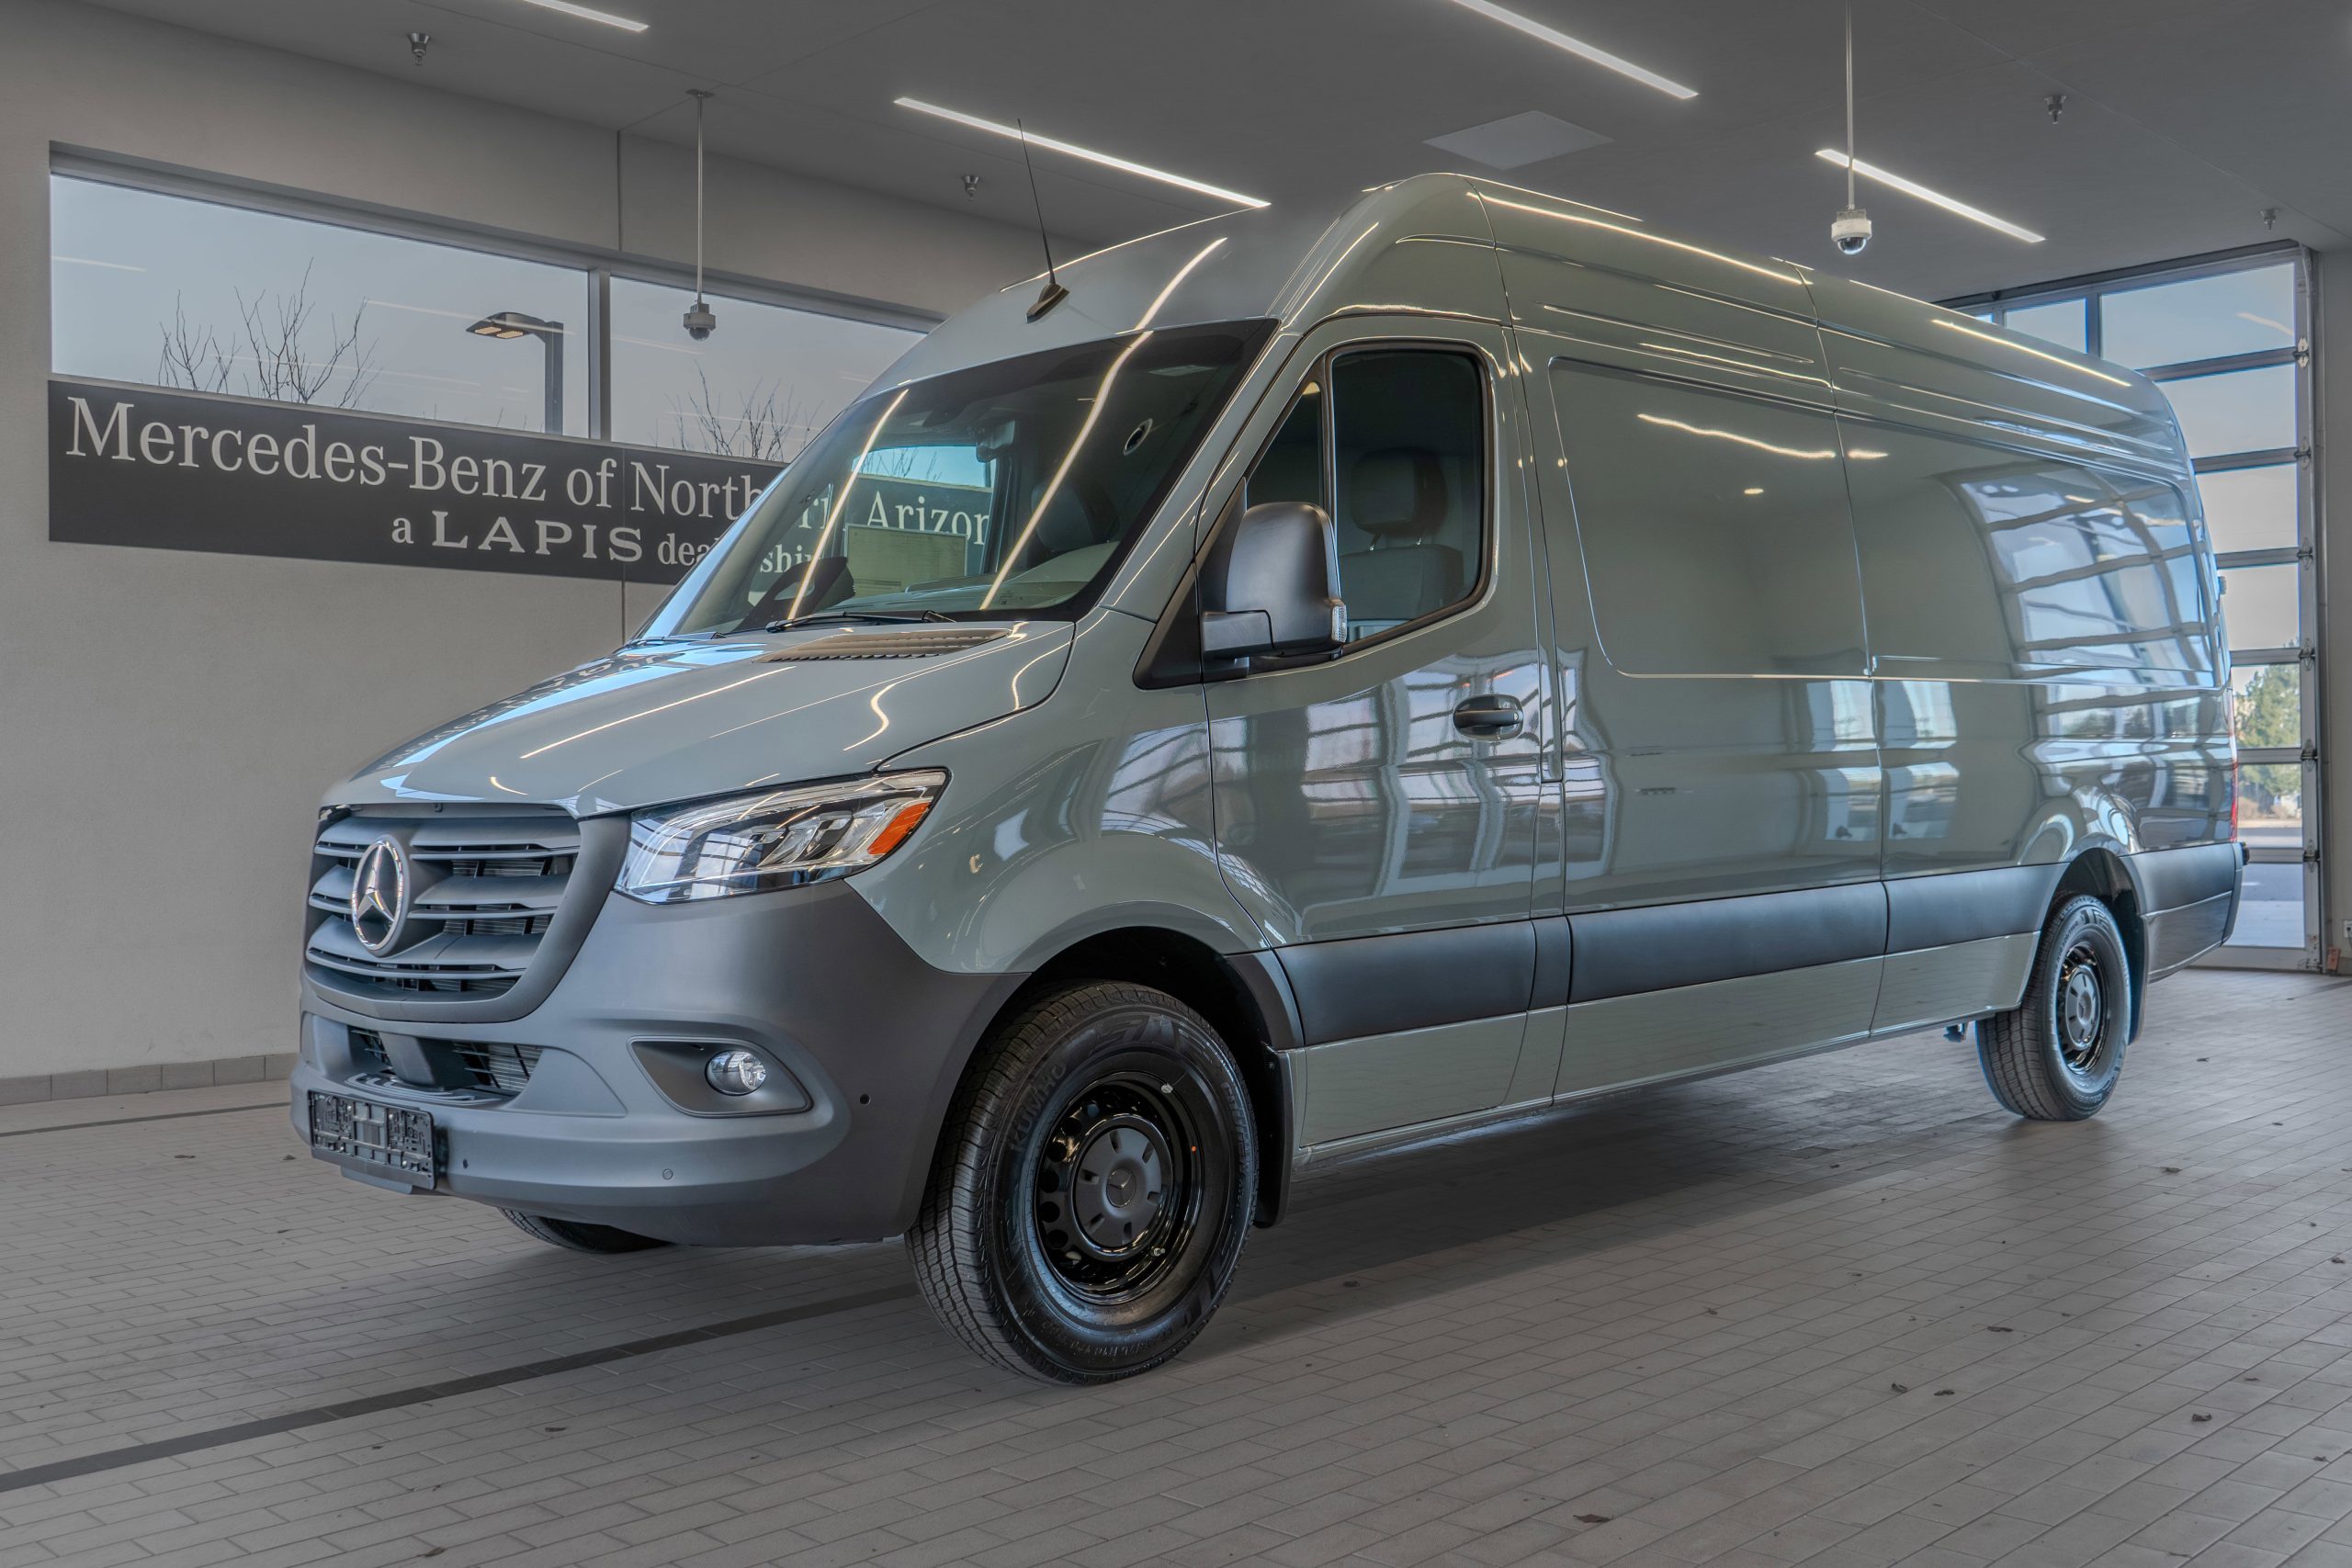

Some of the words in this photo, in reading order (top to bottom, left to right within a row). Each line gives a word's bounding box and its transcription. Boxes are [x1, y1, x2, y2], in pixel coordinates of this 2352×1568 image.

[66, 396, 548, 501] Mercedes-Benz
[566, 458, 616, 507] of
[391, 517, 413, 544] a
[432, 510, 642, 562] LAPIS
[1009, 1063, 1067, 1153] KUMHO
